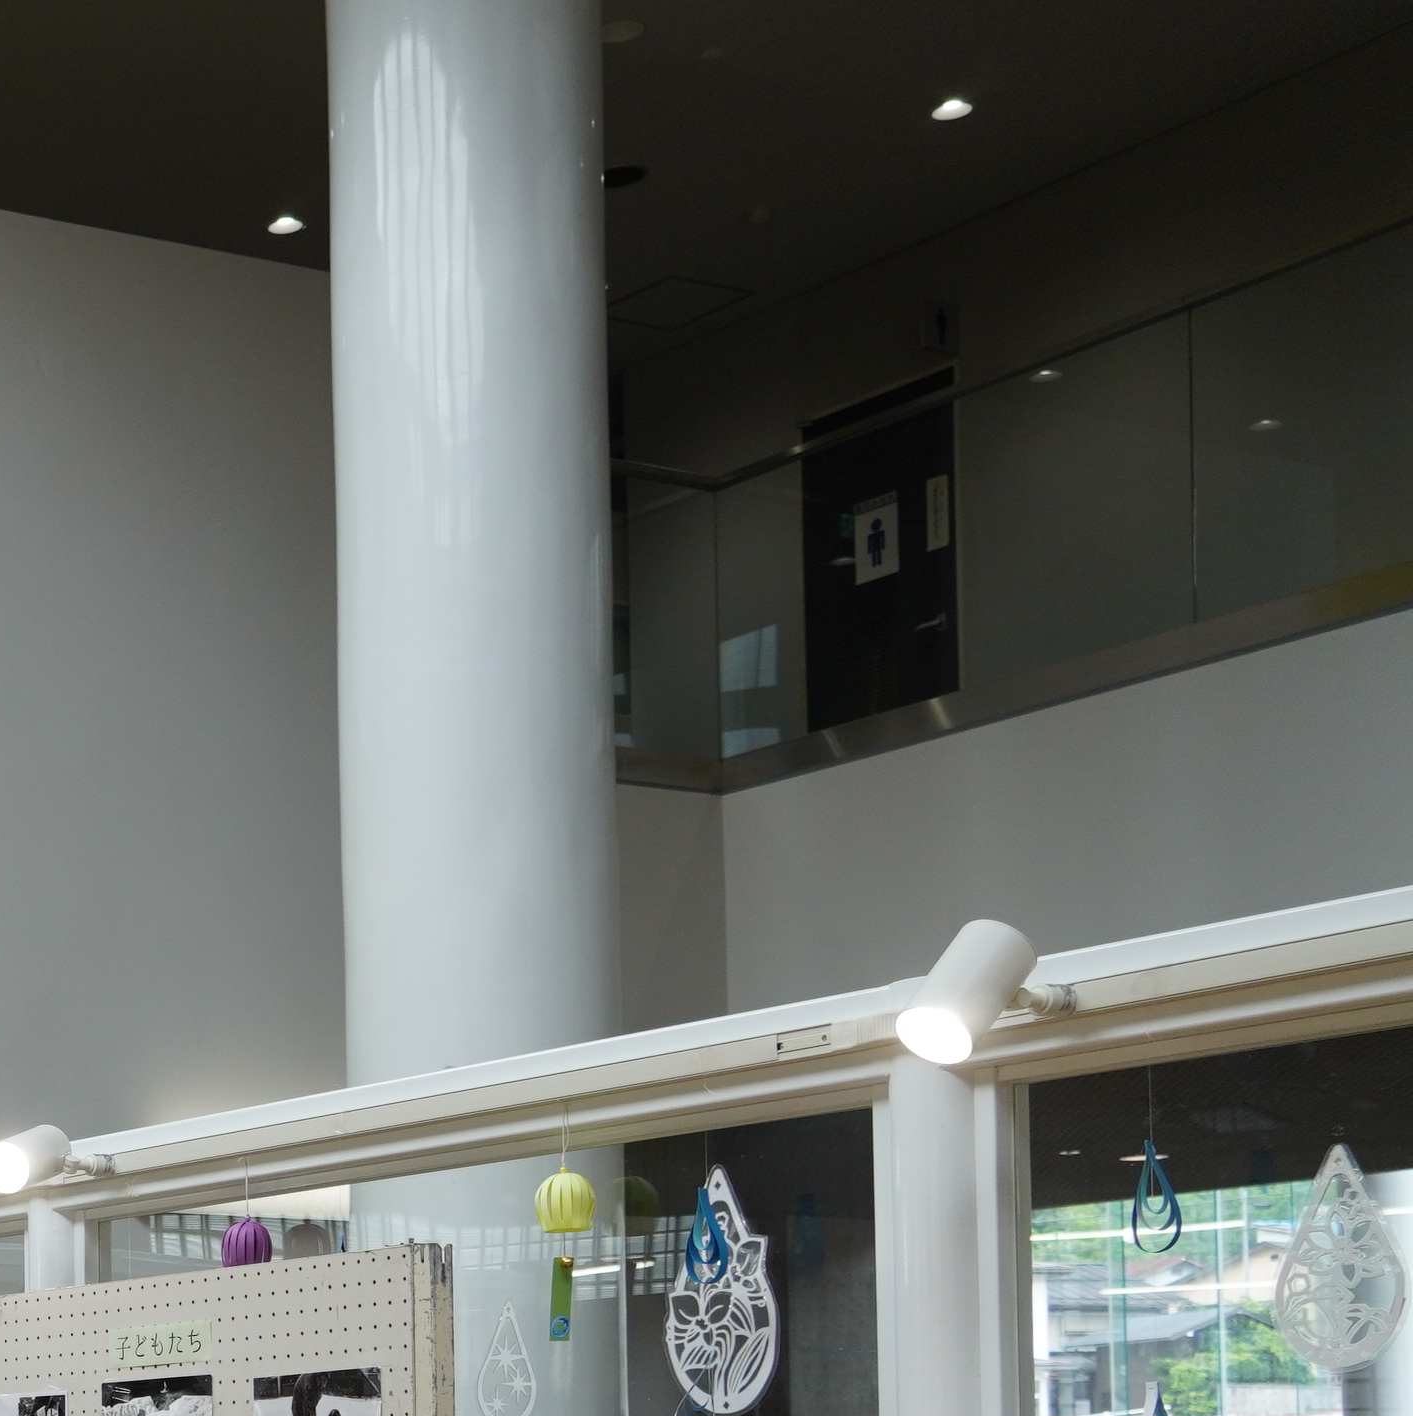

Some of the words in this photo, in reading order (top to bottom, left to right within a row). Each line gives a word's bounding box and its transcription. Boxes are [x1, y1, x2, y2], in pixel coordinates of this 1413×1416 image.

[115, 1328, 202, 1361] 子どもたち
